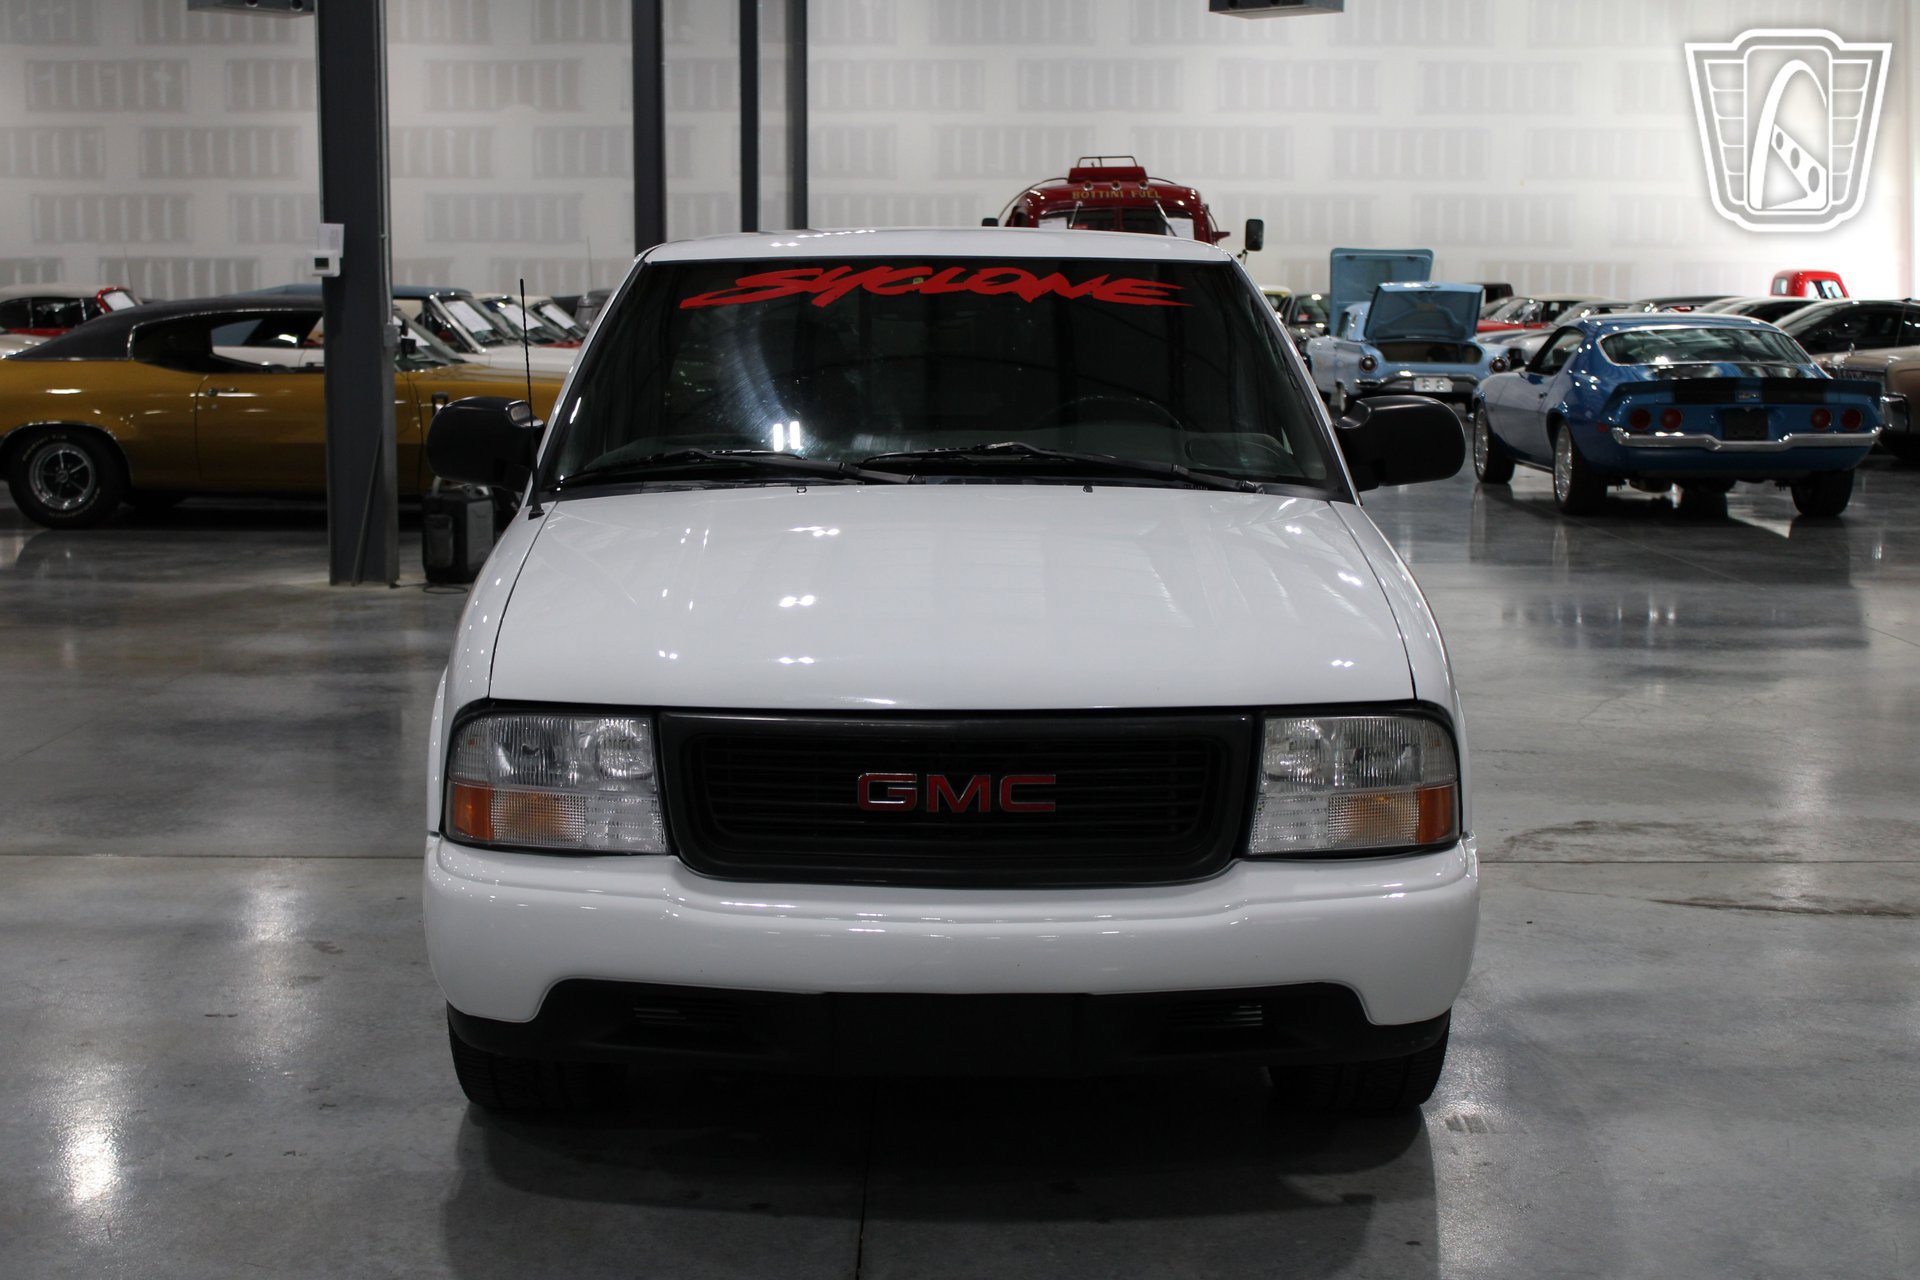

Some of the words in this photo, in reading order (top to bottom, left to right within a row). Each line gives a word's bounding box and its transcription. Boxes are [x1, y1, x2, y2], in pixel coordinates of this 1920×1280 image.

[1072, 190, 1124, 199] BOTTINI
[1131, 189, 1162, 199] FUEL
[679, 265, 1193, 309] SYCLONE
[857, 773, 1056, 813] GMC
